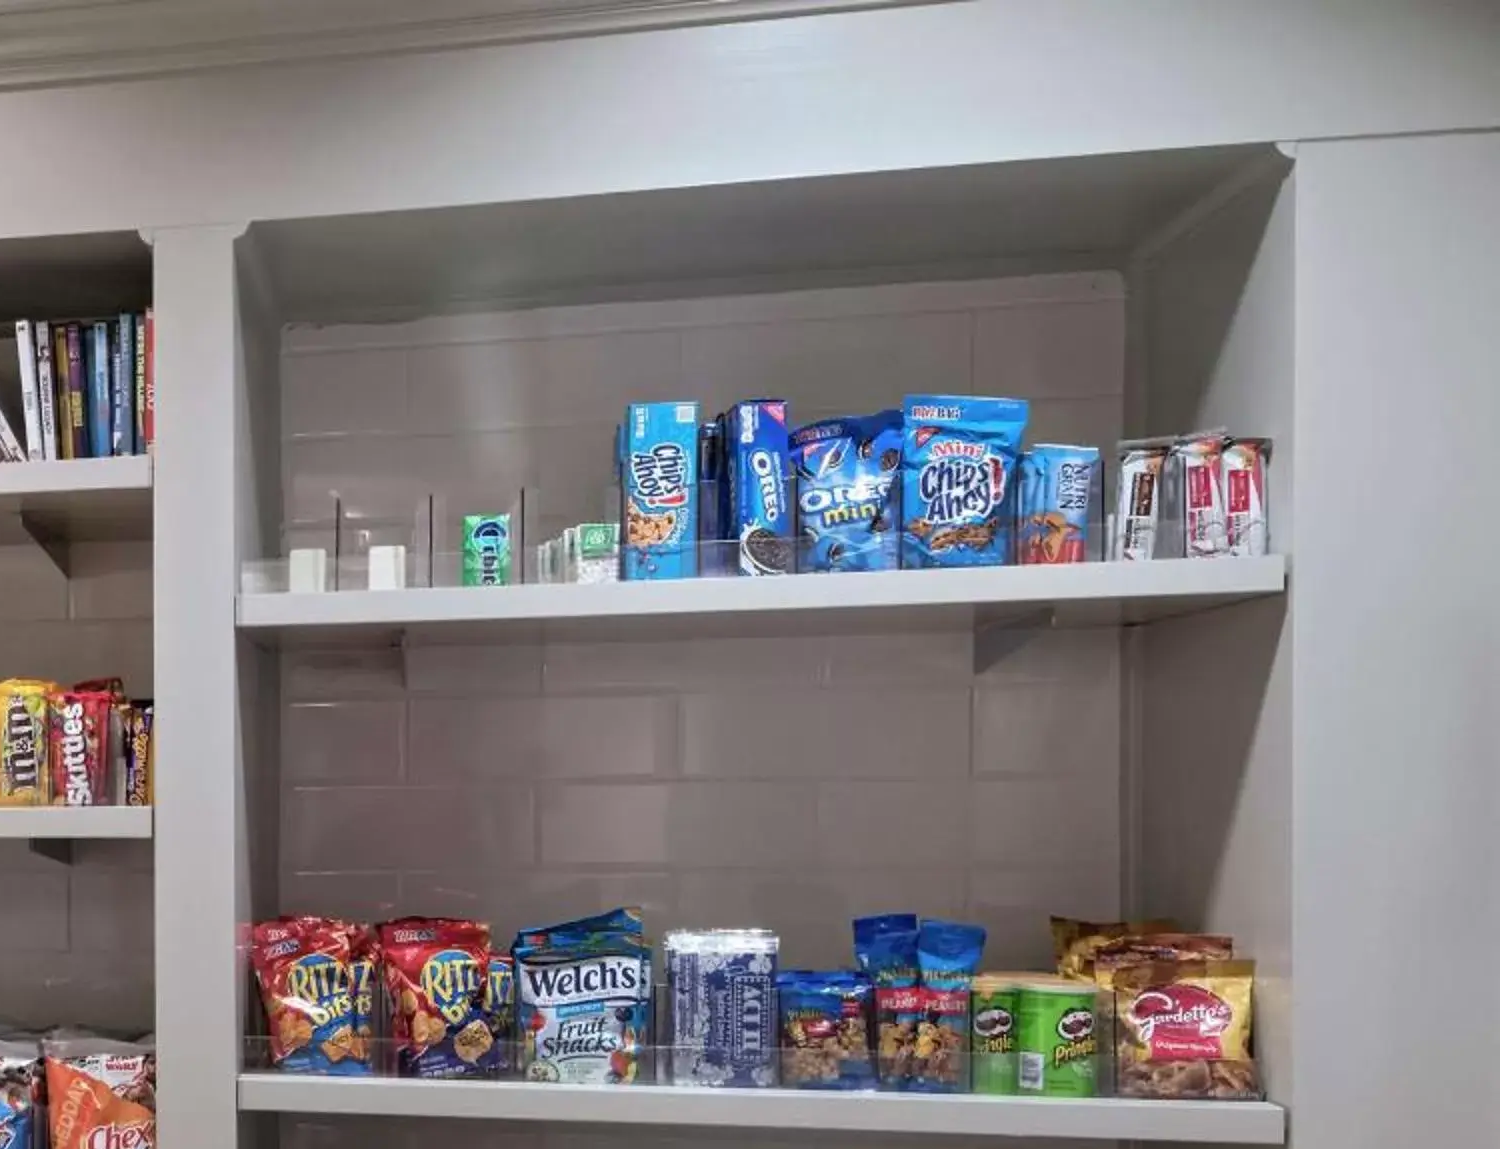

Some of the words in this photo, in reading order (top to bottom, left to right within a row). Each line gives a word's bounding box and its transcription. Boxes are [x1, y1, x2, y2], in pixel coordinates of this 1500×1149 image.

[653, 444, 683, 494] Chips
[752, 451, 778, 522] OREO
[921, 460, 990, 499] Chips
[1059, 463, 1074, 509] GRAIN
[1074, 463, 1091, 509] NUTRI
[289, 962, 347, 1004] RITZ
[524, 961, 637, 998] Welch's
[557, 1016, 609, 1040] Fruit
[1127, 991, 1229, 1042] Gardetto's
[542, 1034, 618, 1059] Snacks
